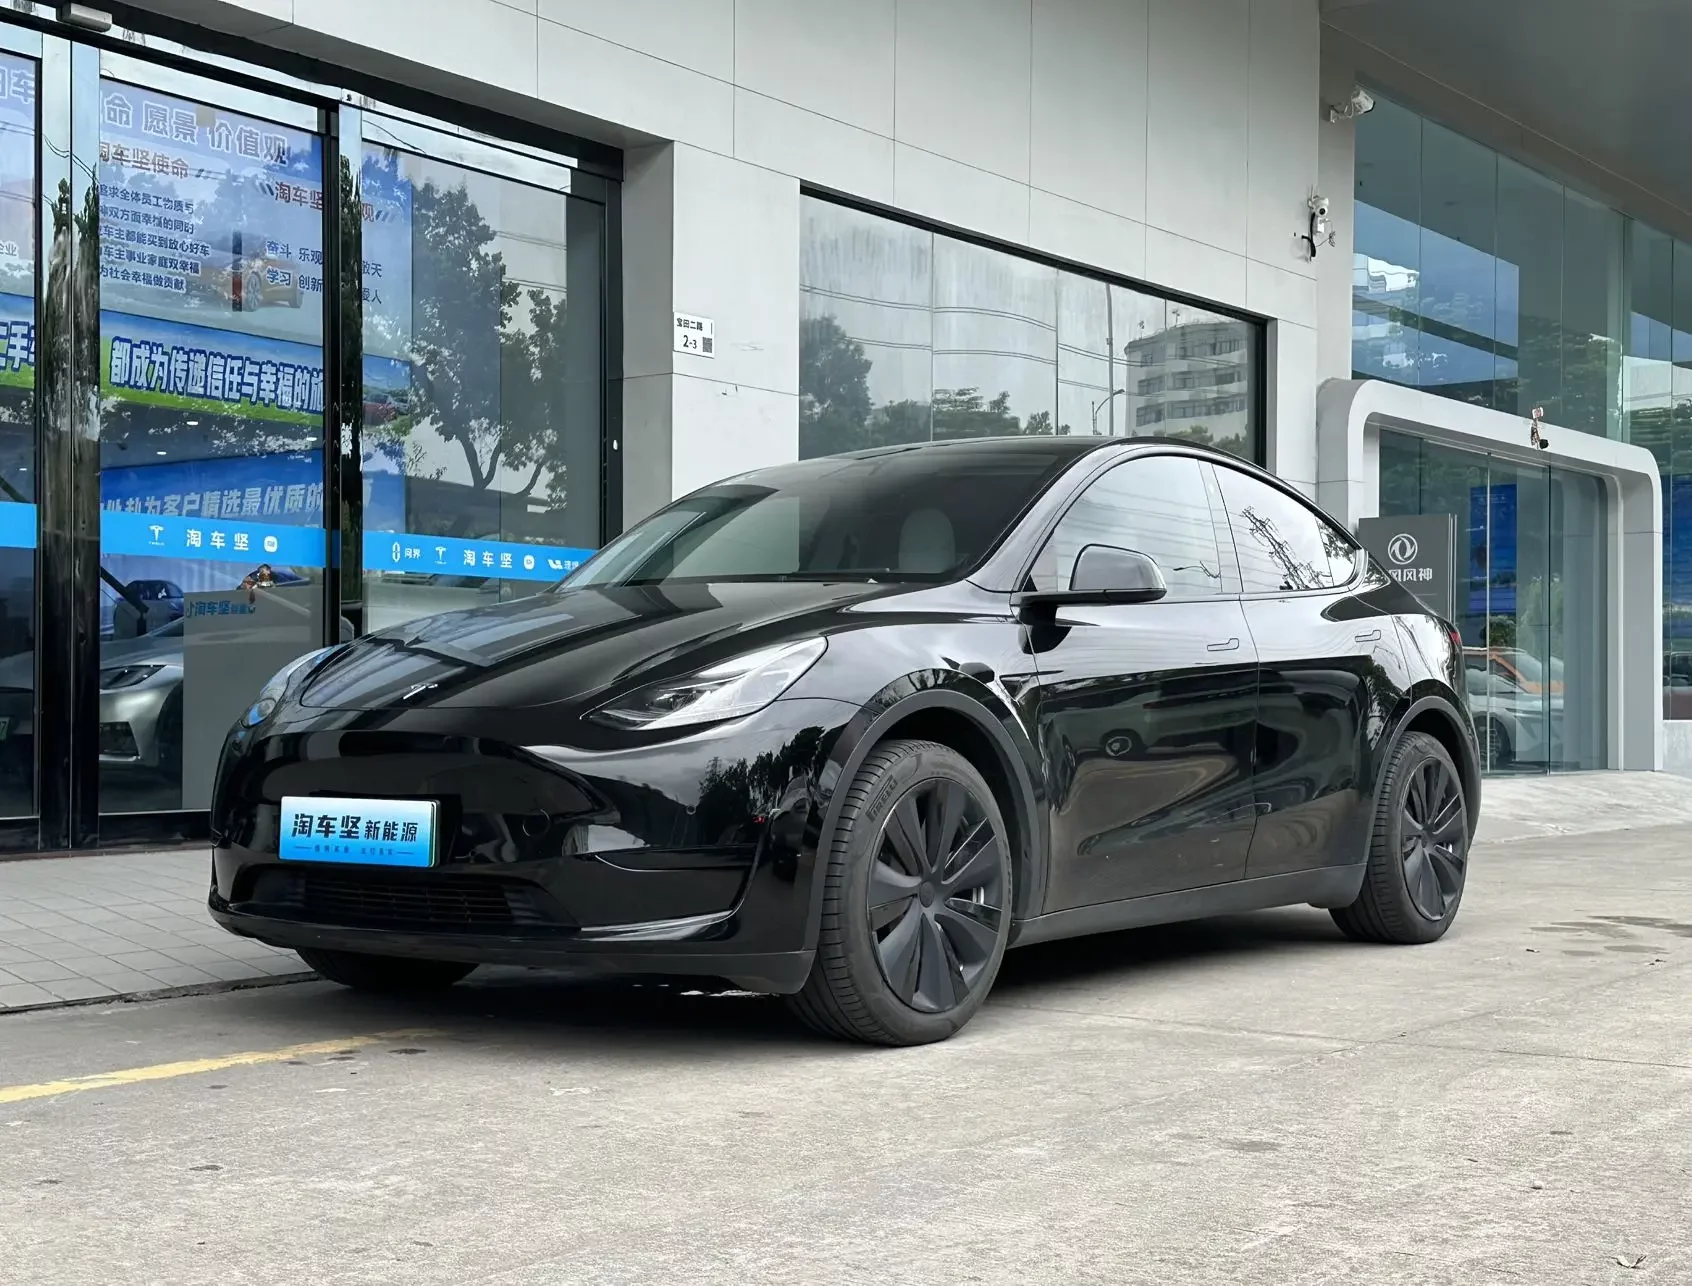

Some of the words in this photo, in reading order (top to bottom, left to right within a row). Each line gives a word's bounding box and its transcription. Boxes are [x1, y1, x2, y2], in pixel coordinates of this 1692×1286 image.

[142, 101, 199, 144] 愿景
[207, 119, 289, 166] 价值观
[100, 225, 210, 256] 车主都能买到放心好车
[267, 240, 292, 259] 奋斗
[100, 245, 200, 274] 车主事业家庭双幸福
[267, 268, 291, 286] 学习
[299, 275, 322, 292] 创新
[186, 529, 249, 551] 淘车坚
[463, 549, 513, 568] 淘车坚
